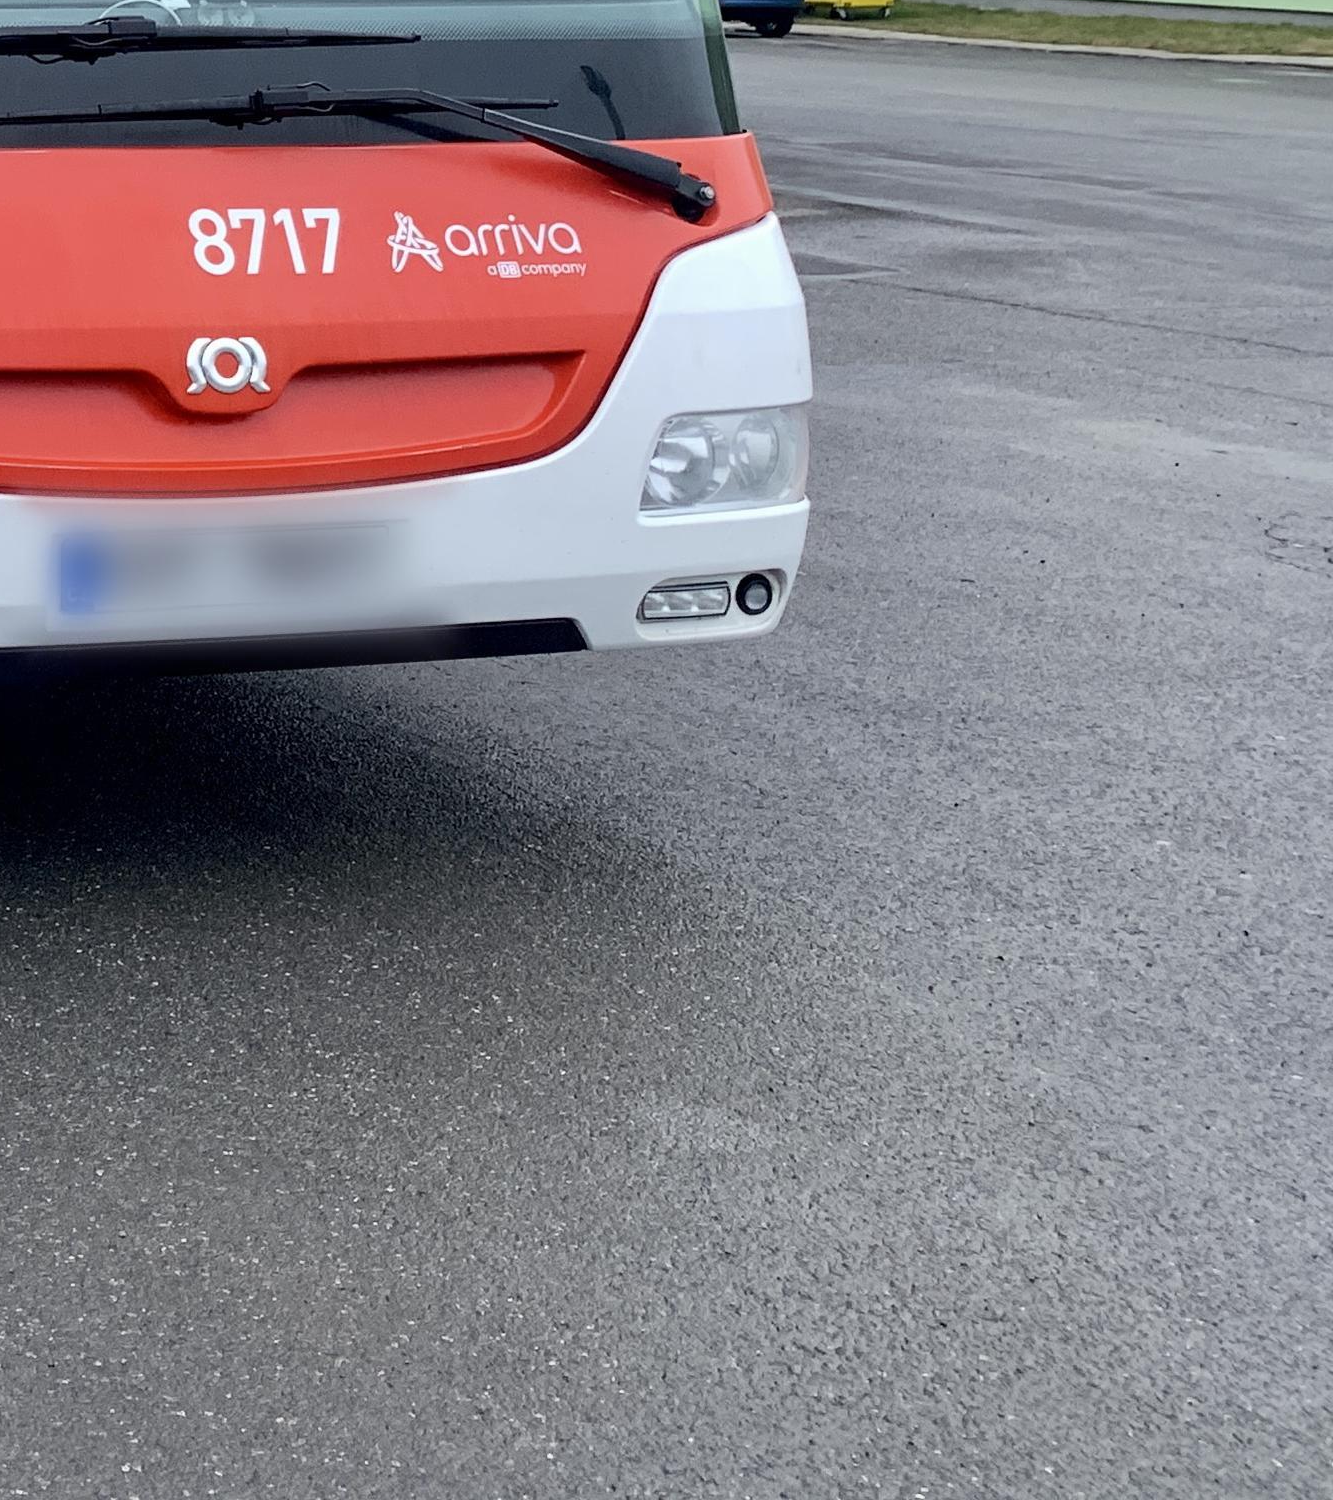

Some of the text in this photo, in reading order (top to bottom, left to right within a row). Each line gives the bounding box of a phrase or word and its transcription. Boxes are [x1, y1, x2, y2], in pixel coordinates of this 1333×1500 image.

[188, 208, 341, 275] 8717
[444, 214, 583, 257] arriva
[521, 262, 587, 277] company
